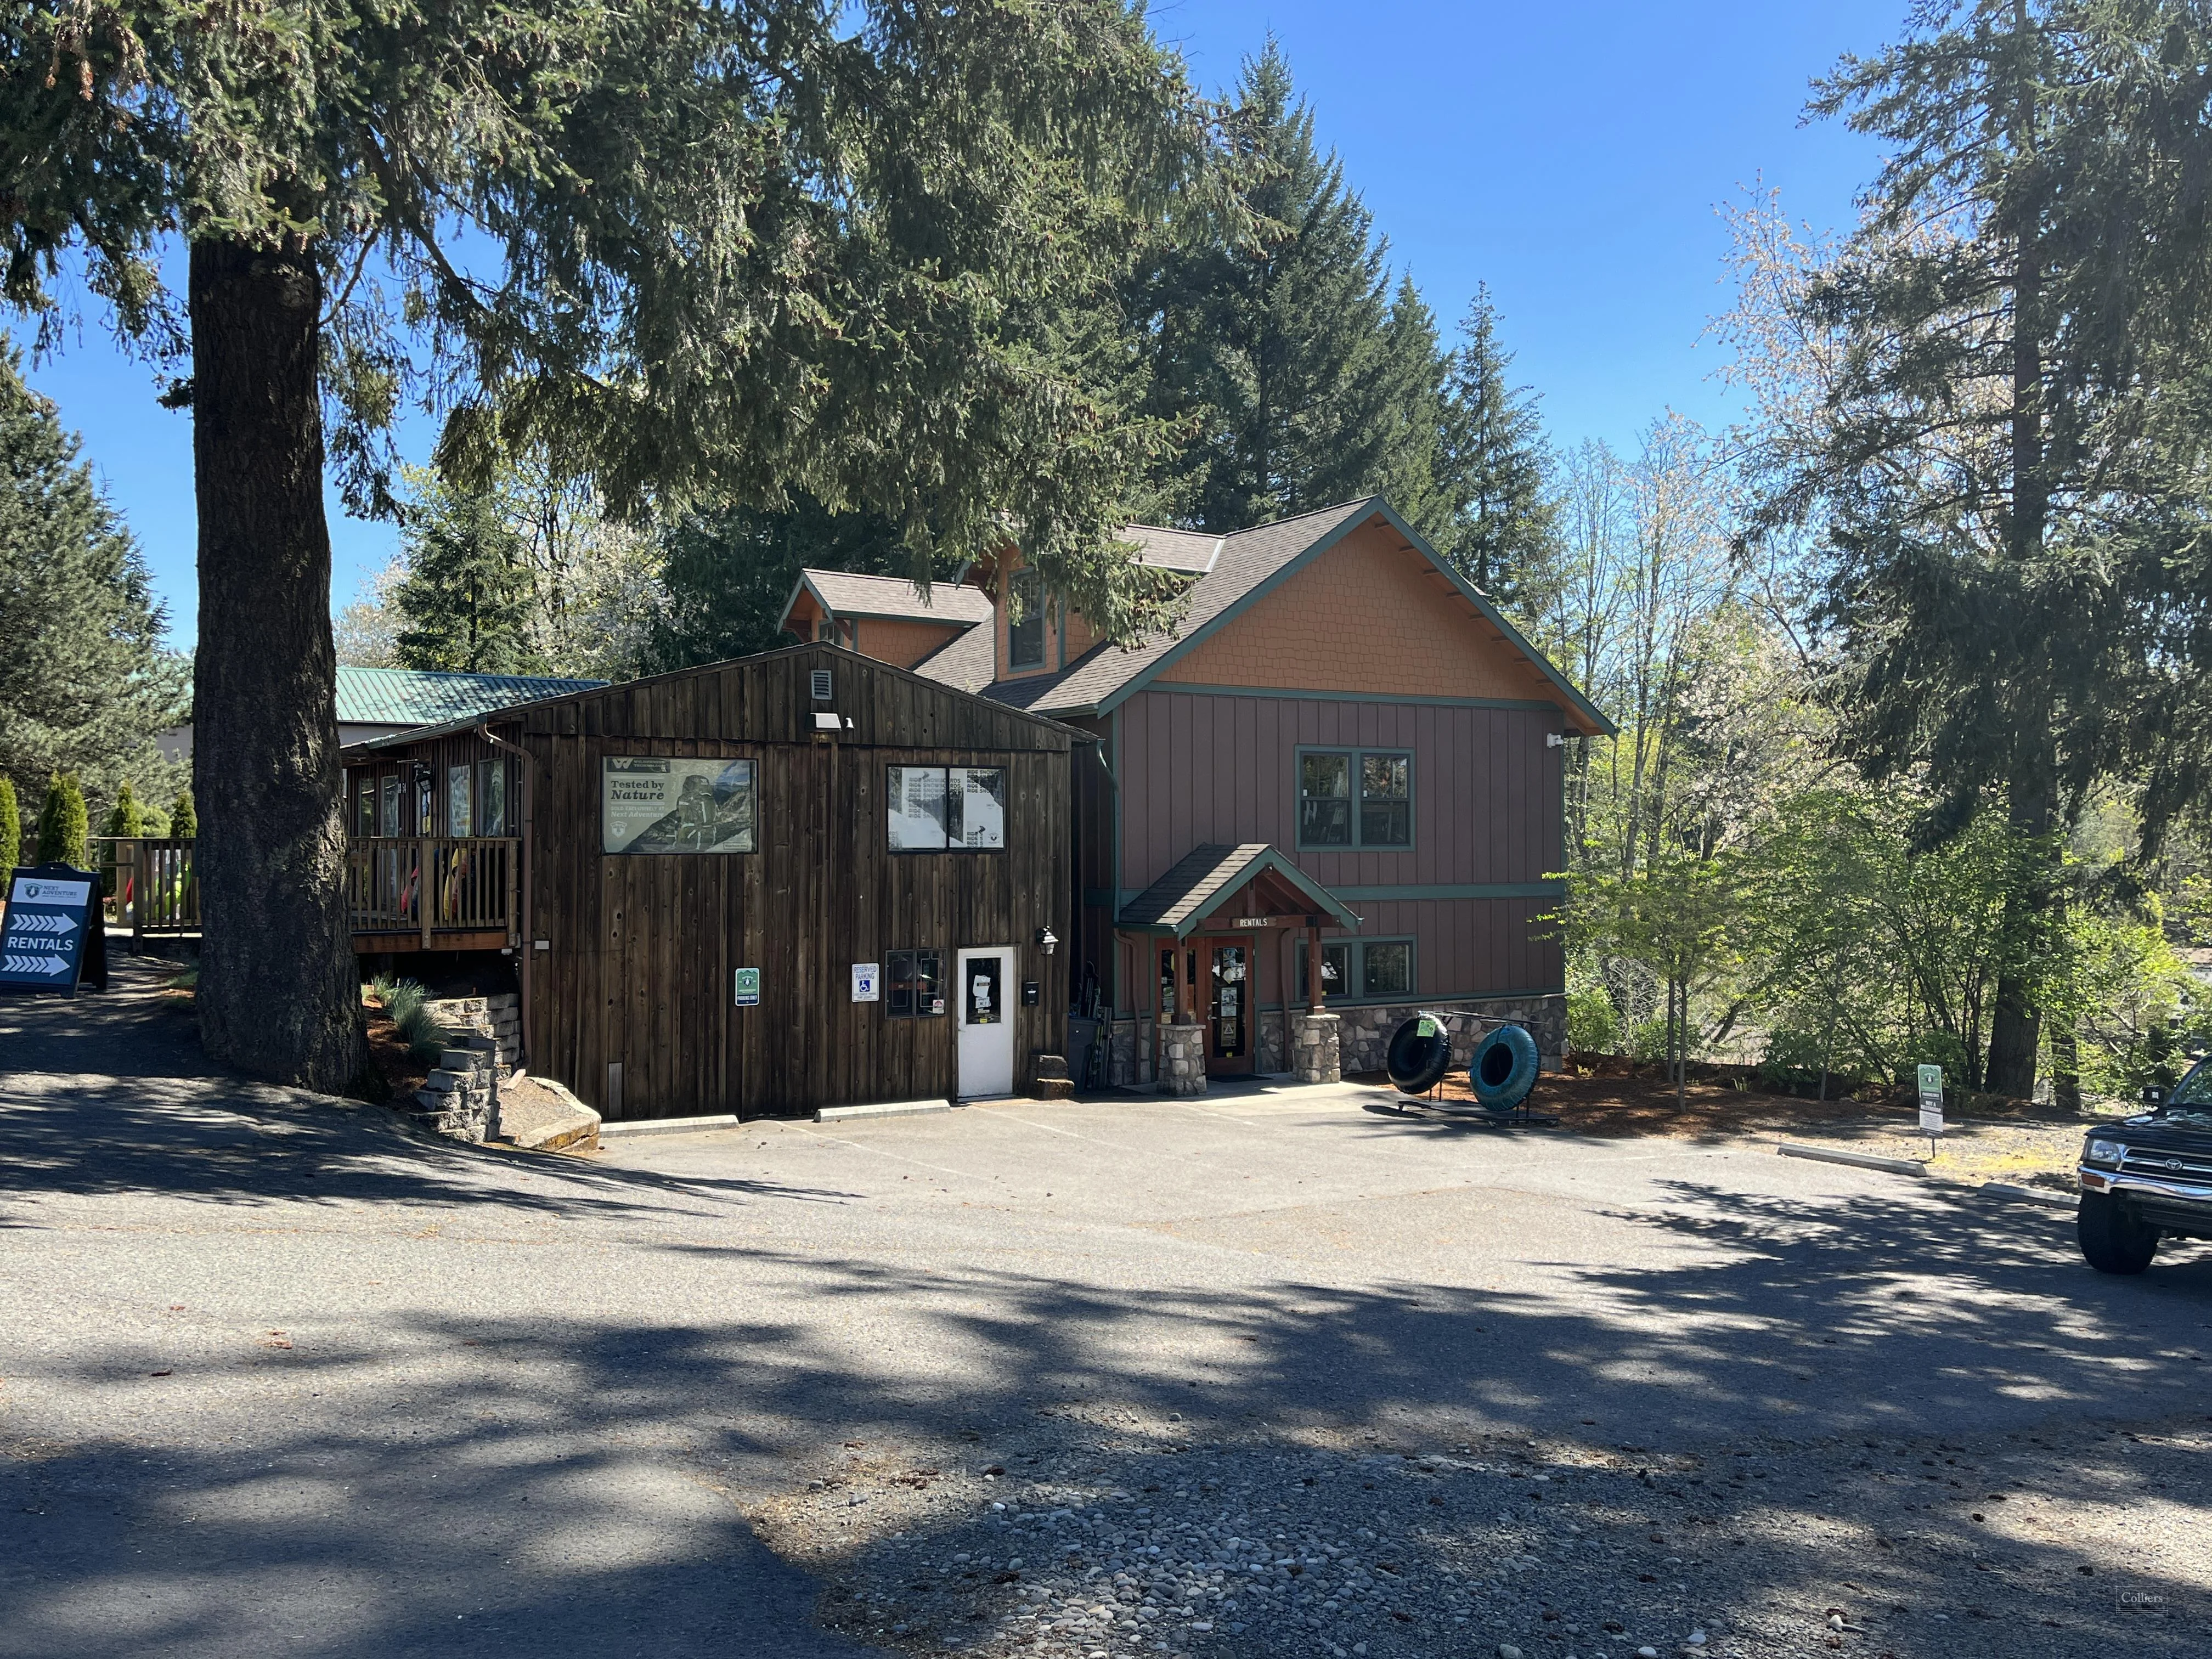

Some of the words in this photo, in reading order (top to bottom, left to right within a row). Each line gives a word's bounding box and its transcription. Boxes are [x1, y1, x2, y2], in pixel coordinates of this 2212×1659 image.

[651, 781, 664, 791] by
[611, 790, 664, 800] Nature
[1240, 918, 1267, 927] RENTALS
[7, 936, 74, 951] RENTALS
